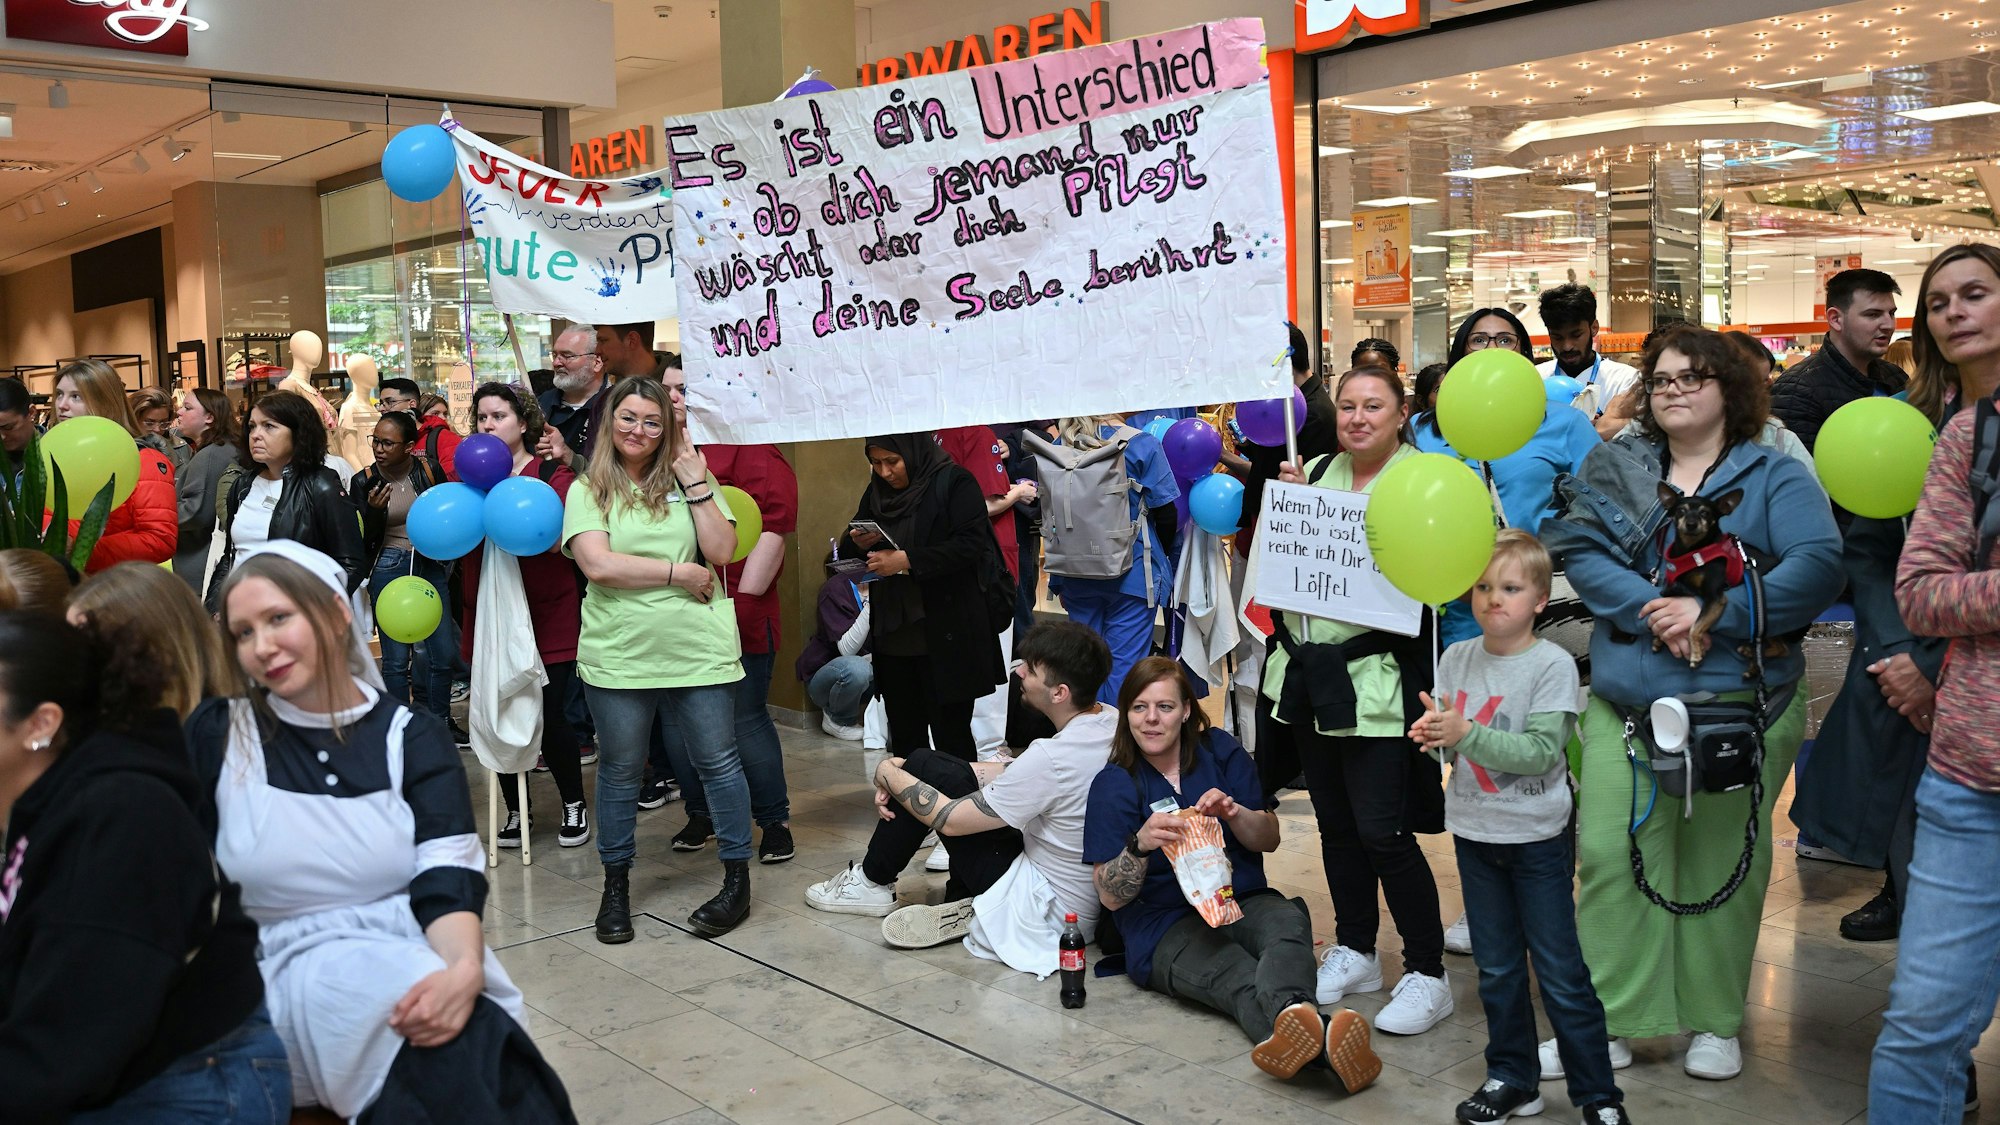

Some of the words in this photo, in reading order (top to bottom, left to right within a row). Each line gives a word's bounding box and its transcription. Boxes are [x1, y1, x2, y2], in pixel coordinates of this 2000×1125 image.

[664, 125, 747, 188] Es
[774, 99, 843, 177] ist
[874, 88, 957, 149] ein
[971, 25, 1216, 139] Unterschied
[754, 183, 800, 237] ob
[821, 166, 902, 226] dich
[914, 121, 1099, 226] jemand
[1121, 105, 1204, 154] nur
[540, 203, 672, 231] verdient
[475, 231, 579, 282] gute
[619, 228, 675, 284] Pf
[695, 229, 833, 300] wäscht
[859, 218, 922, 264] oder
[954, 196, 1026, 247] dich
[710, 289, 781, 357] und
[813, 280, 920, 338] deine
[946, 270, 1064, 321] Seele
[1083, 222, 1236, 292] berührt
[1269, 520, 1293, 534] wie
[1301, 520, 1320, 537] Du
[1329, 525, 1361, 544] isst,
[1271, 488, 1311, 516] Wenn
[1315, 496, 1336, 520] Du
[1268, 541, 1310, 557] reiche
[1315, 544, 1335, 562] ich
[1342, 549, 1366, 569] Dir
